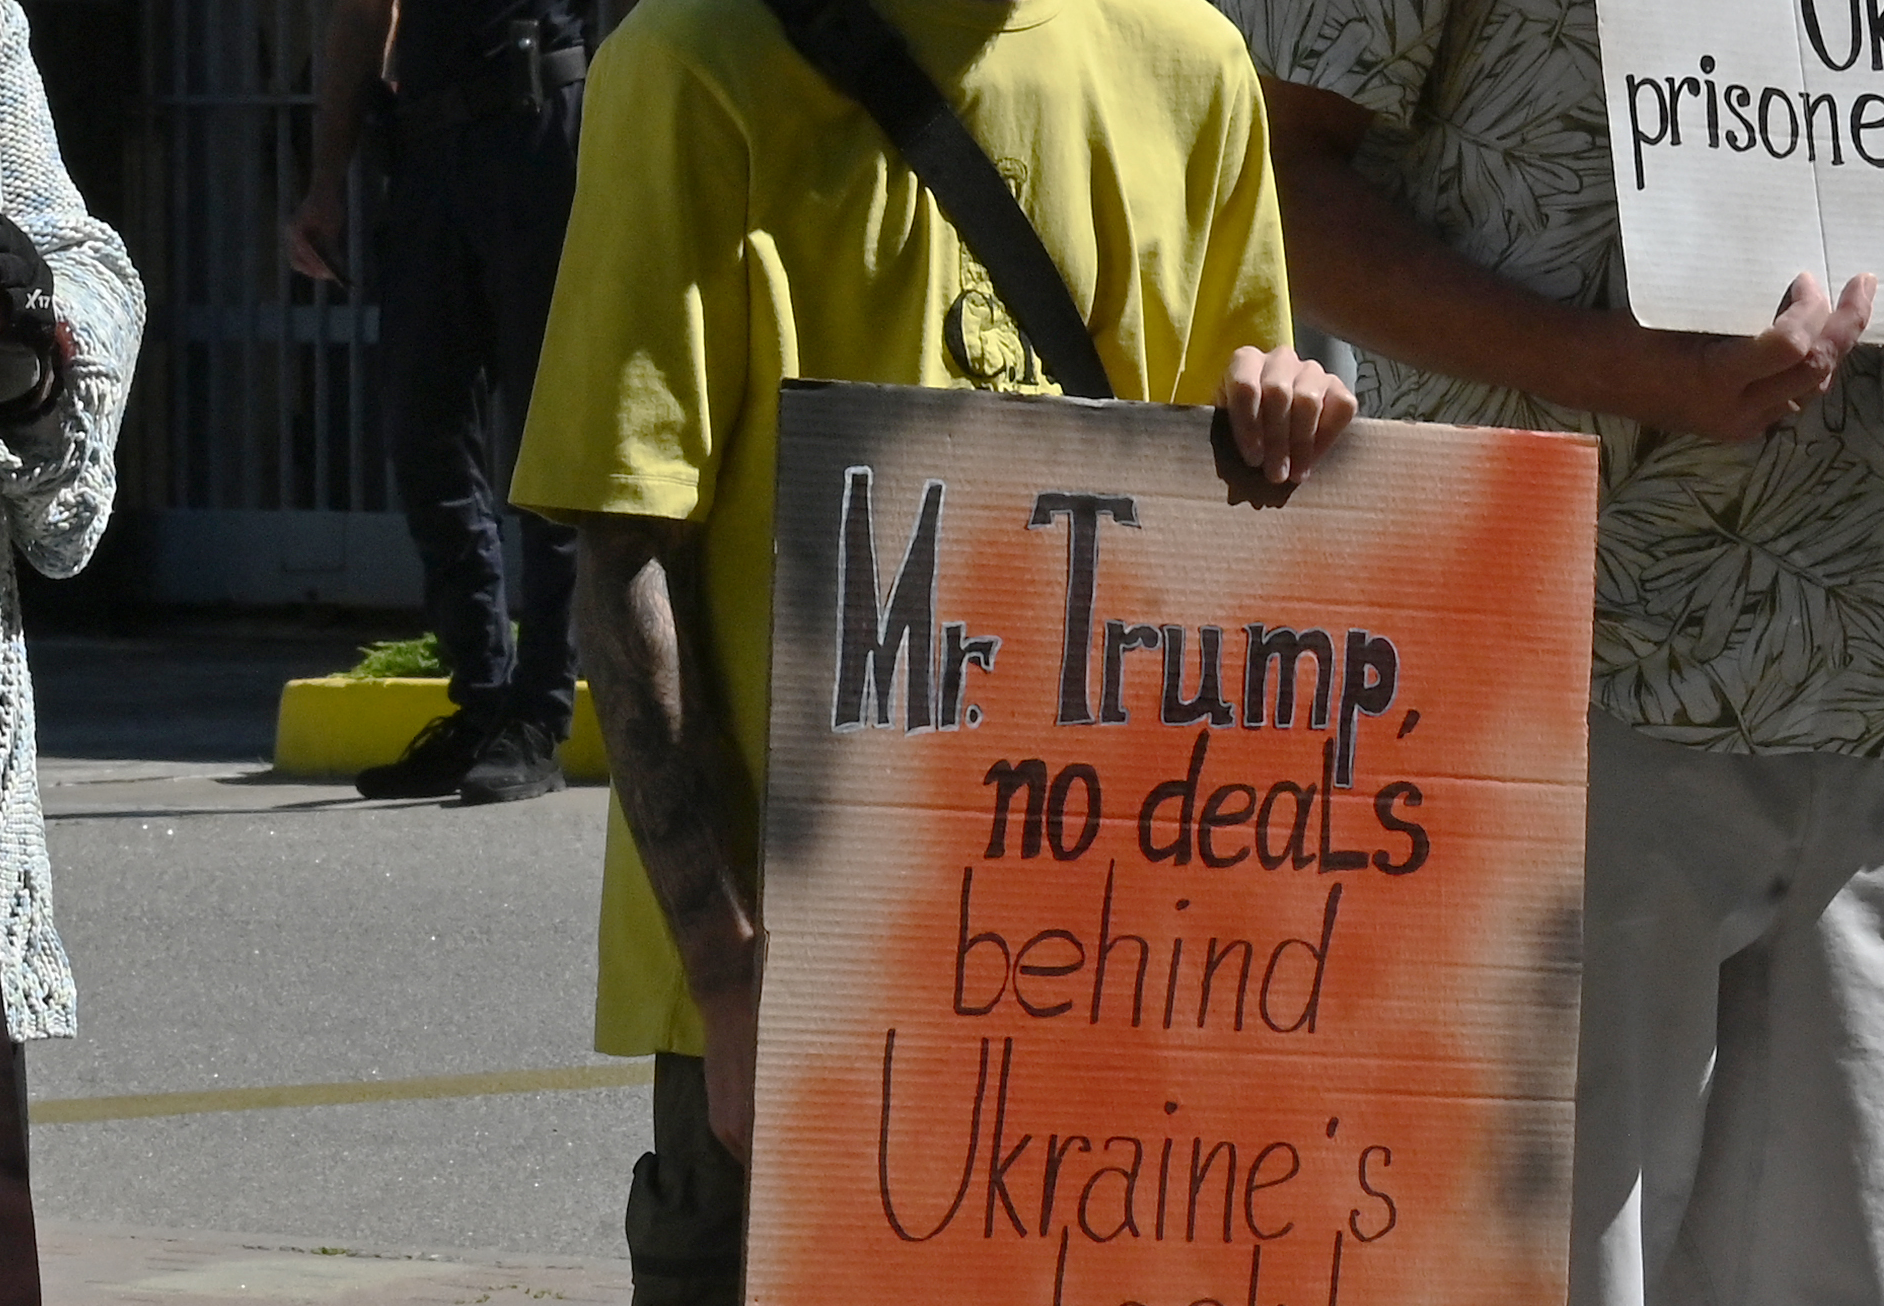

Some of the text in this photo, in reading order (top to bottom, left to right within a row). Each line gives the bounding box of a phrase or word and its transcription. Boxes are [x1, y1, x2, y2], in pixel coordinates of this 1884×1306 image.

[831, 465, 1422, 790] Mr. Trump,
[981, 755, 1101, 863] no
[951, 859, 1343, 1036] behind
[879, 1027, 1400, 1245] Ukraine's
